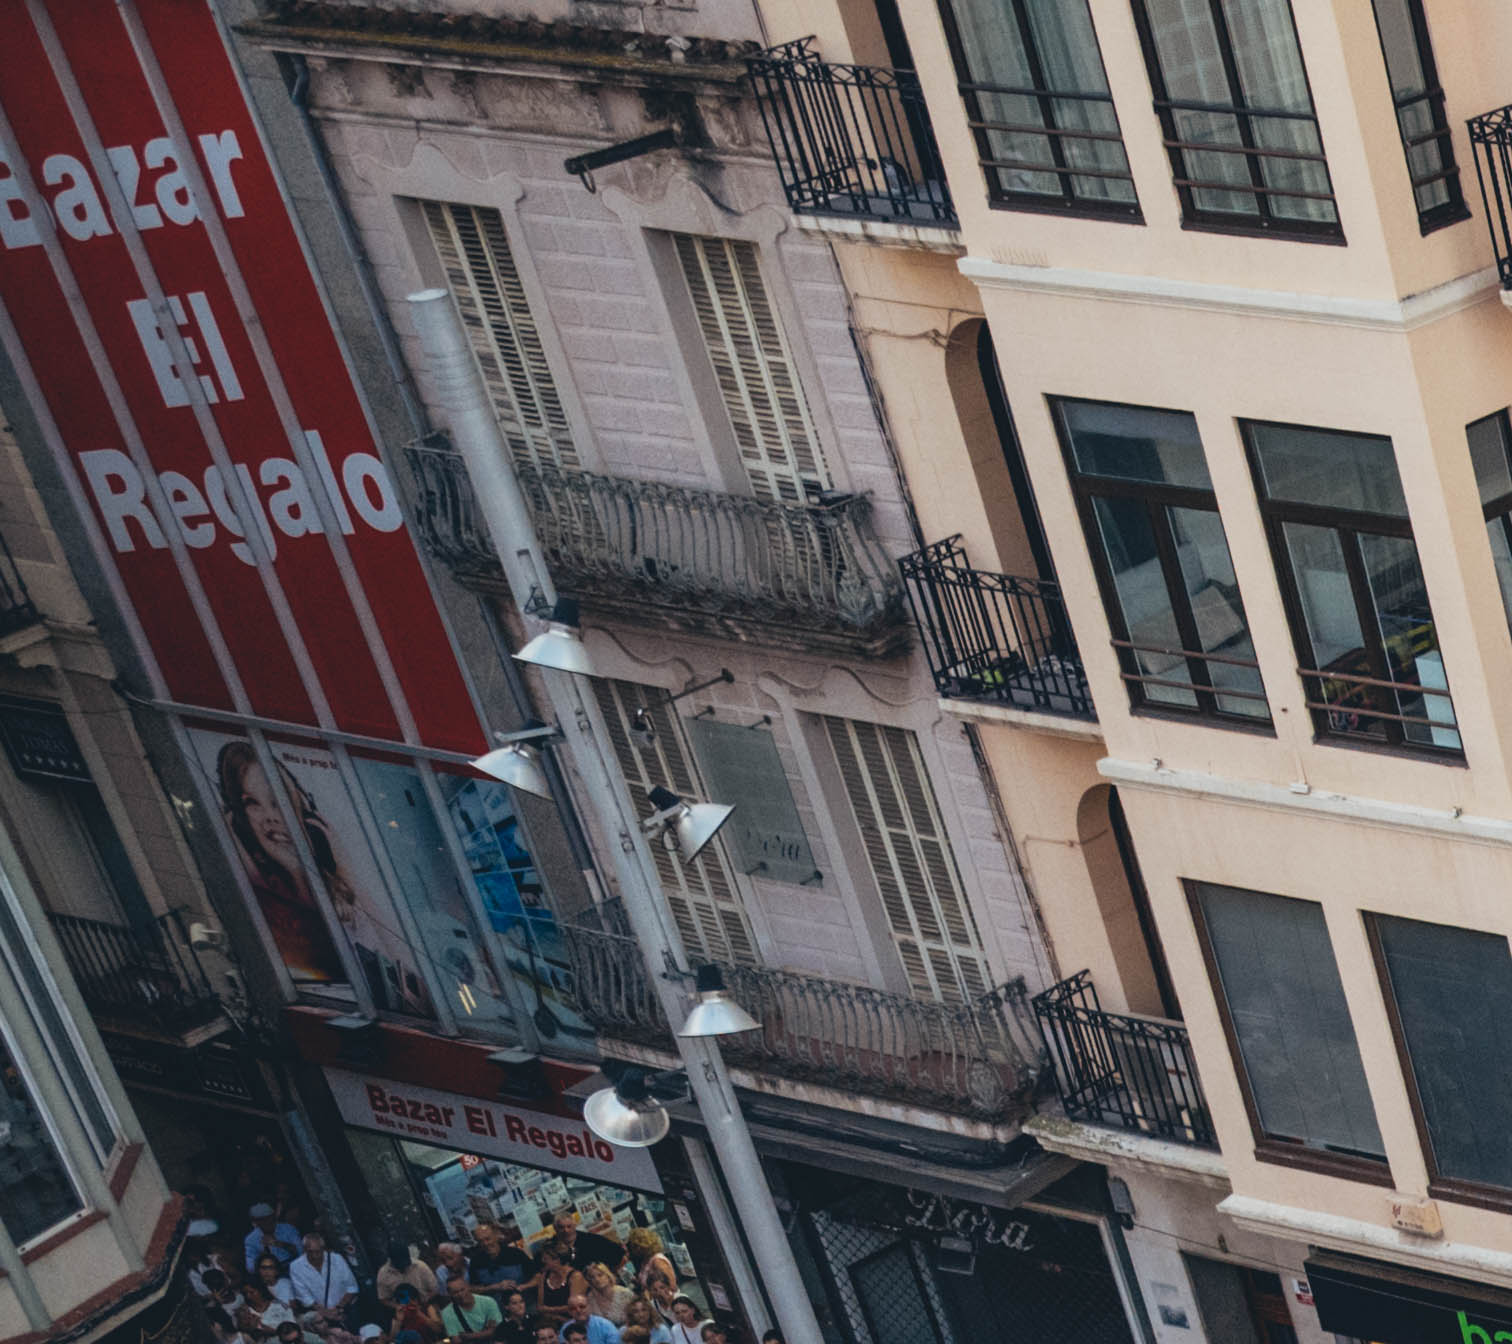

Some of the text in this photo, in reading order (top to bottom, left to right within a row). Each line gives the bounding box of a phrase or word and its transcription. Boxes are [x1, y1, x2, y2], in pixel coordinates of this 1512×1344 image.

[0, 129, 245, 250] Bazar
[126, 291, 245, 408] El
[79, 430, 404, 567] Regalo
[365, 1084, 614, 1163] Bazar El Regalo
